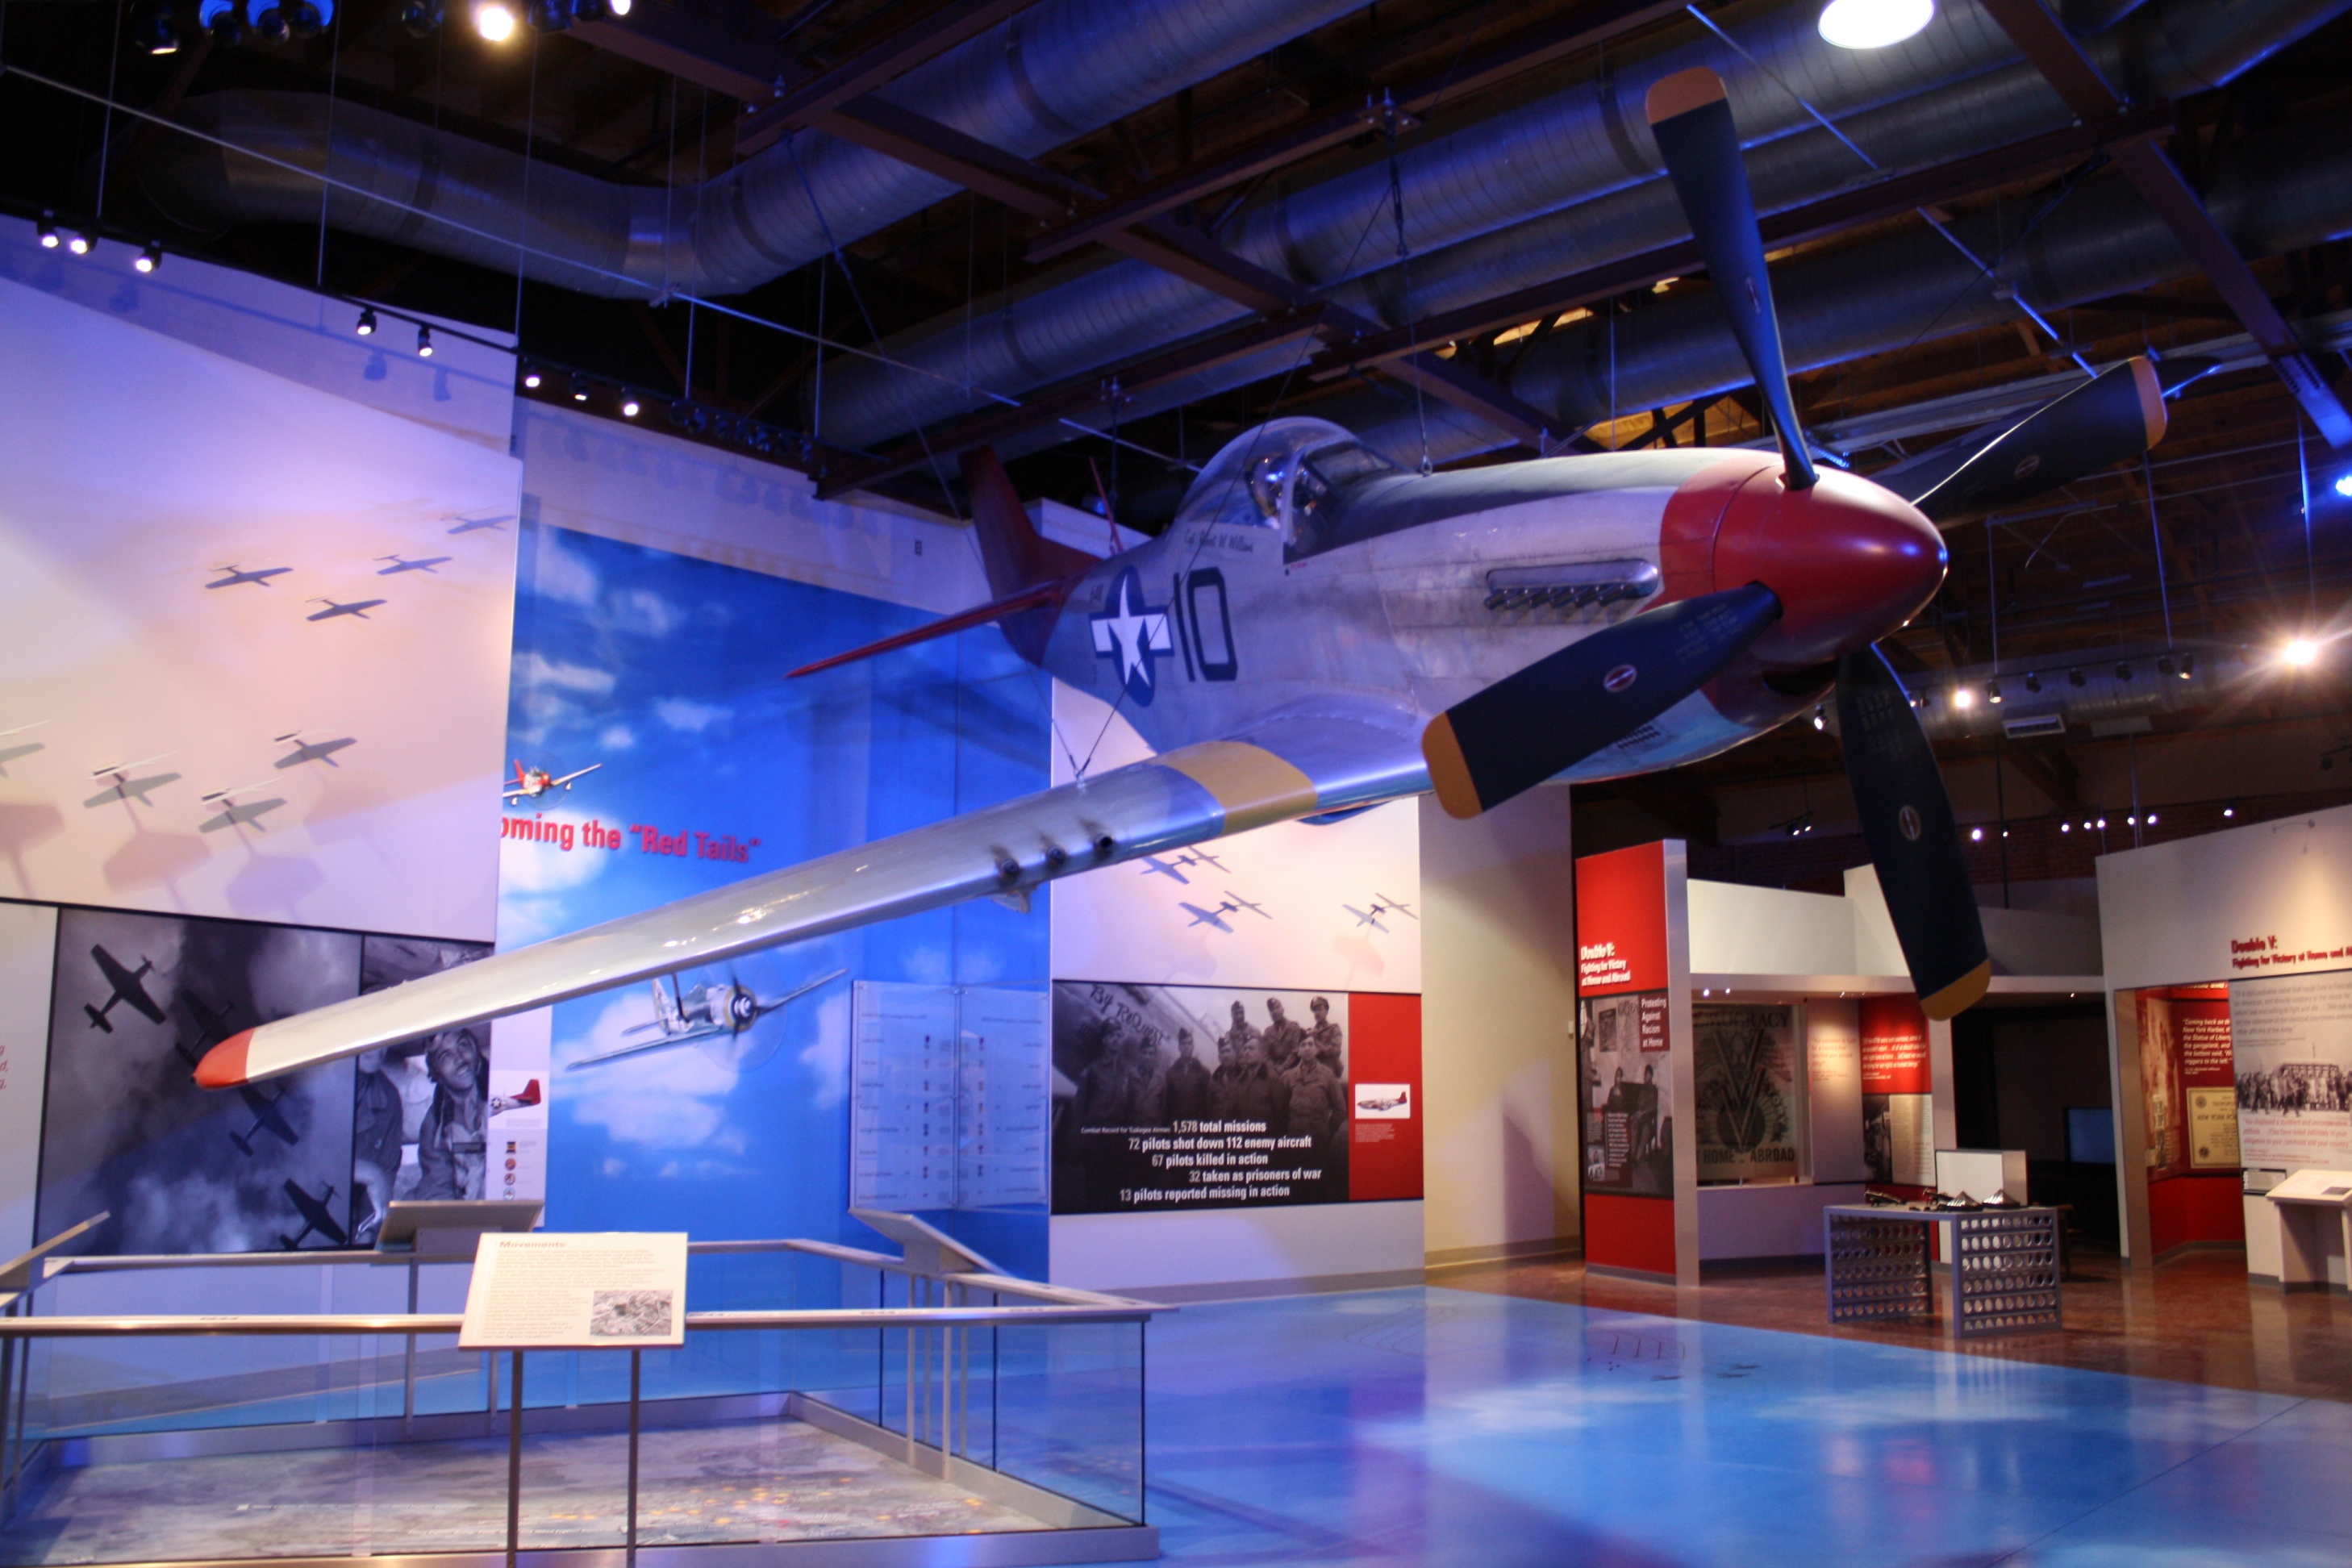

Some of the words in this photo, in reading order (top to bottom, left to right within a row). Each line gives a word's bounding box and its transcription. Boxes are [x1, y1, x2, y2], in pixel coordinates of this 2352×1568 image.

[1174, 566, 1238, 682] 10
[582, 820, 621, 849] the
[629, 824, 688, 857] “Red
[694, 831, 761, 862] Tails”
[1581, 944, 1607, 961] Double
[2231, 937, 2266, 953] Double
[2271, 953, 2296, 965] Victory
[1090, 983, 1113, 1014] By
[1173, 1120, 1198, 1133] 1,578
[1199, 1120, 1223, 1132] total
[1224, 1120, 1266, 1132] missions
[1128, 1138, 1141, 1150] 72
[1141, 1136, 1170, 1153] pilots
[1173, 1136, 1195, 1150] shot
[1196, 1136, 1224, 1149] down
[1226, 1136, 1242, 1149] 112
[1245, 1138, 1276, 1151] enemy
[1278, 1135, 1312, 1149] aircraft
[1152, 1154, 1164, 1166] 67
[1166, 1153, 1194, 1170] pilots
[1196, 1152, 1224, 1166] killed
[1226, 1153, 1236, 1166] in
[1237, 1152, 1269, 1165] action
[1704, 1149, 1735, 1164] HOME
[1749, 1147, 1795, 1162] ABROAD
[1189, 1170, 1200, 1183] 32
[1202, 1170, 1230, 1182] taken
[1232, 1172, 1244, 1182] as
[1245, 1169, 1291, 1184] prisoners
[1291, 1167, 1302, 1180] of
[1303, 1170, 1322, 1179] war
[1120, 1189, 1132, 1202] 13
[1133, 1187, 1162, 1204] pilots
[1165, 1186, 1207, 1203] reported
[1209, 1185, 1247, 1200] missing
[1249, 1184, 1258, 1198] in
[1260, 1184, 1291, 1197] action
[498, 1241, 565, 1249] Movements
